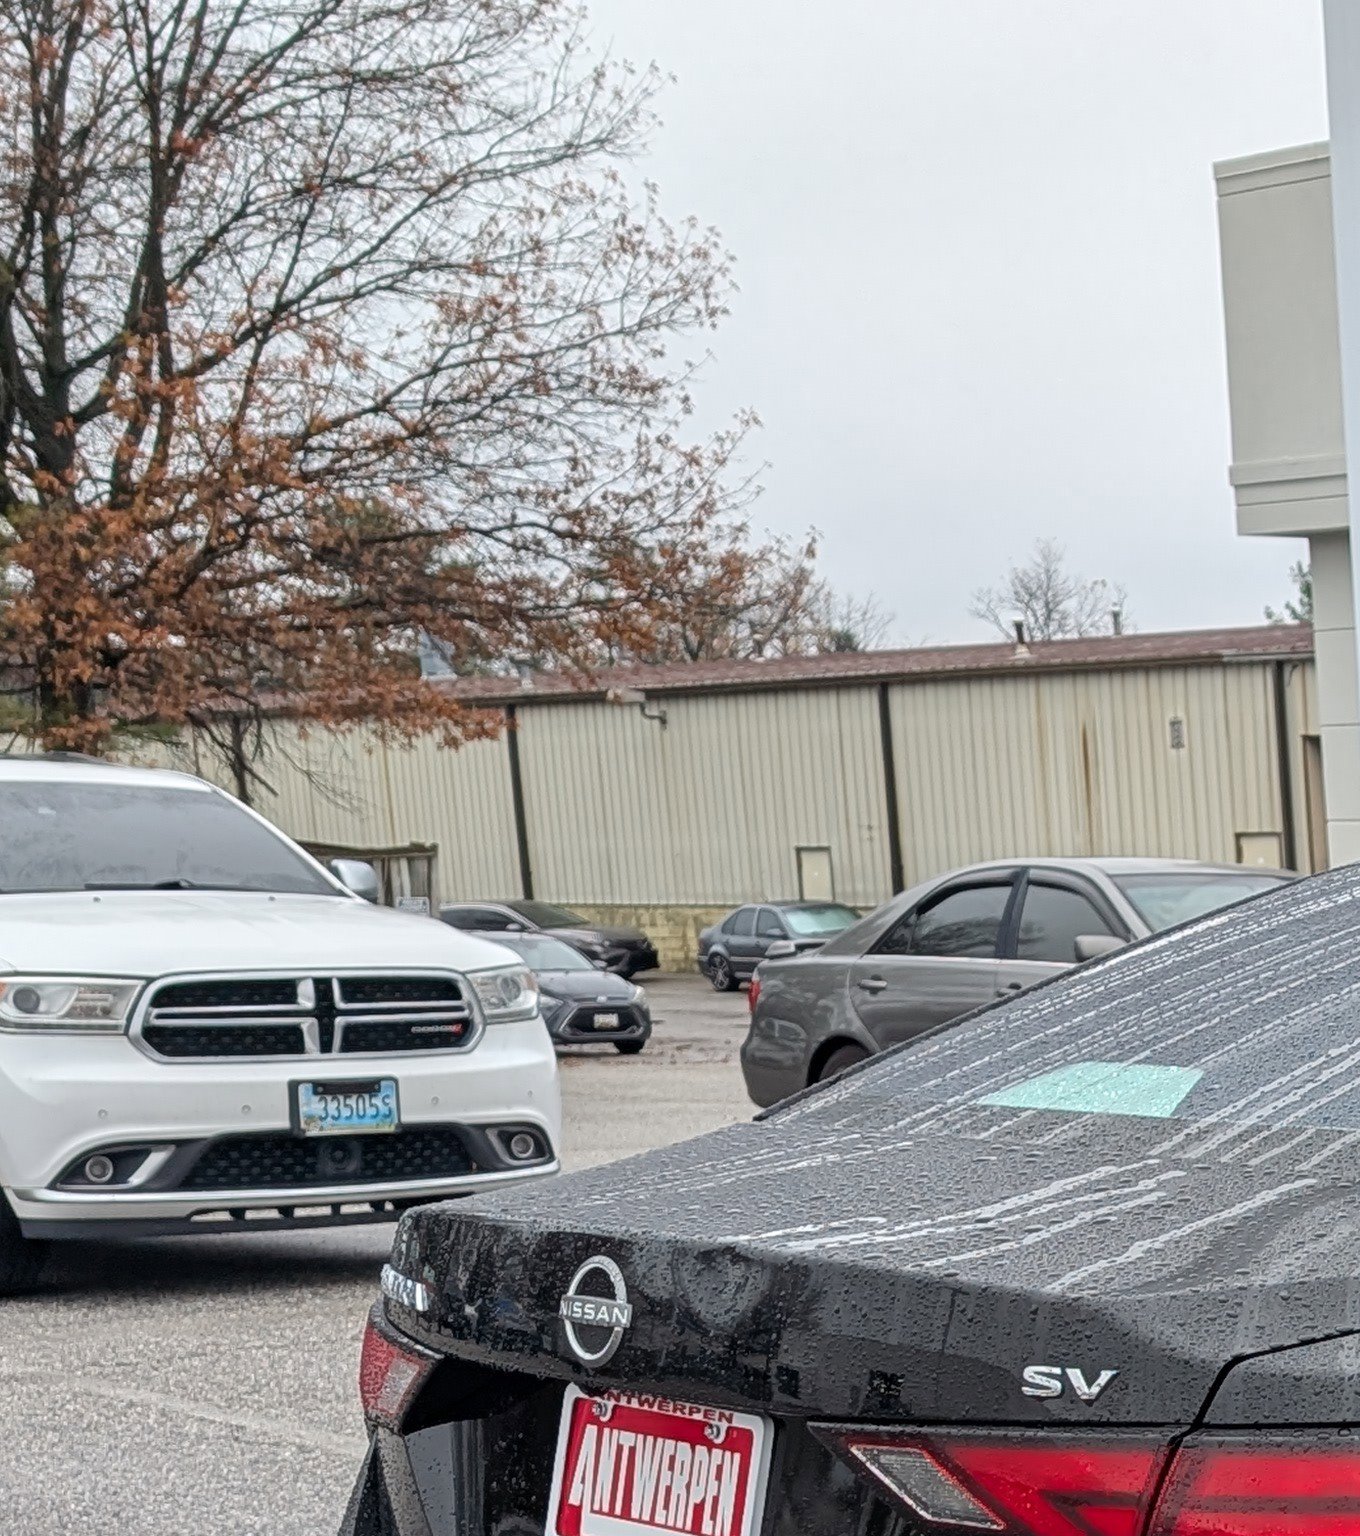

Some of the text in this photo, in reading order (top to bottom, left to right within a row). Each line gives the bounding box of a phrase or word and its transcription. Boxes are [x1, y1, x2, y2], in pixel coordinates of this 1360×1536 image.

[559, 1301, 628, 1324] NISSAN
[1021, 1365, 1119, 1400] SV
[604, 1388, 734, 1424] NTWERPEN
